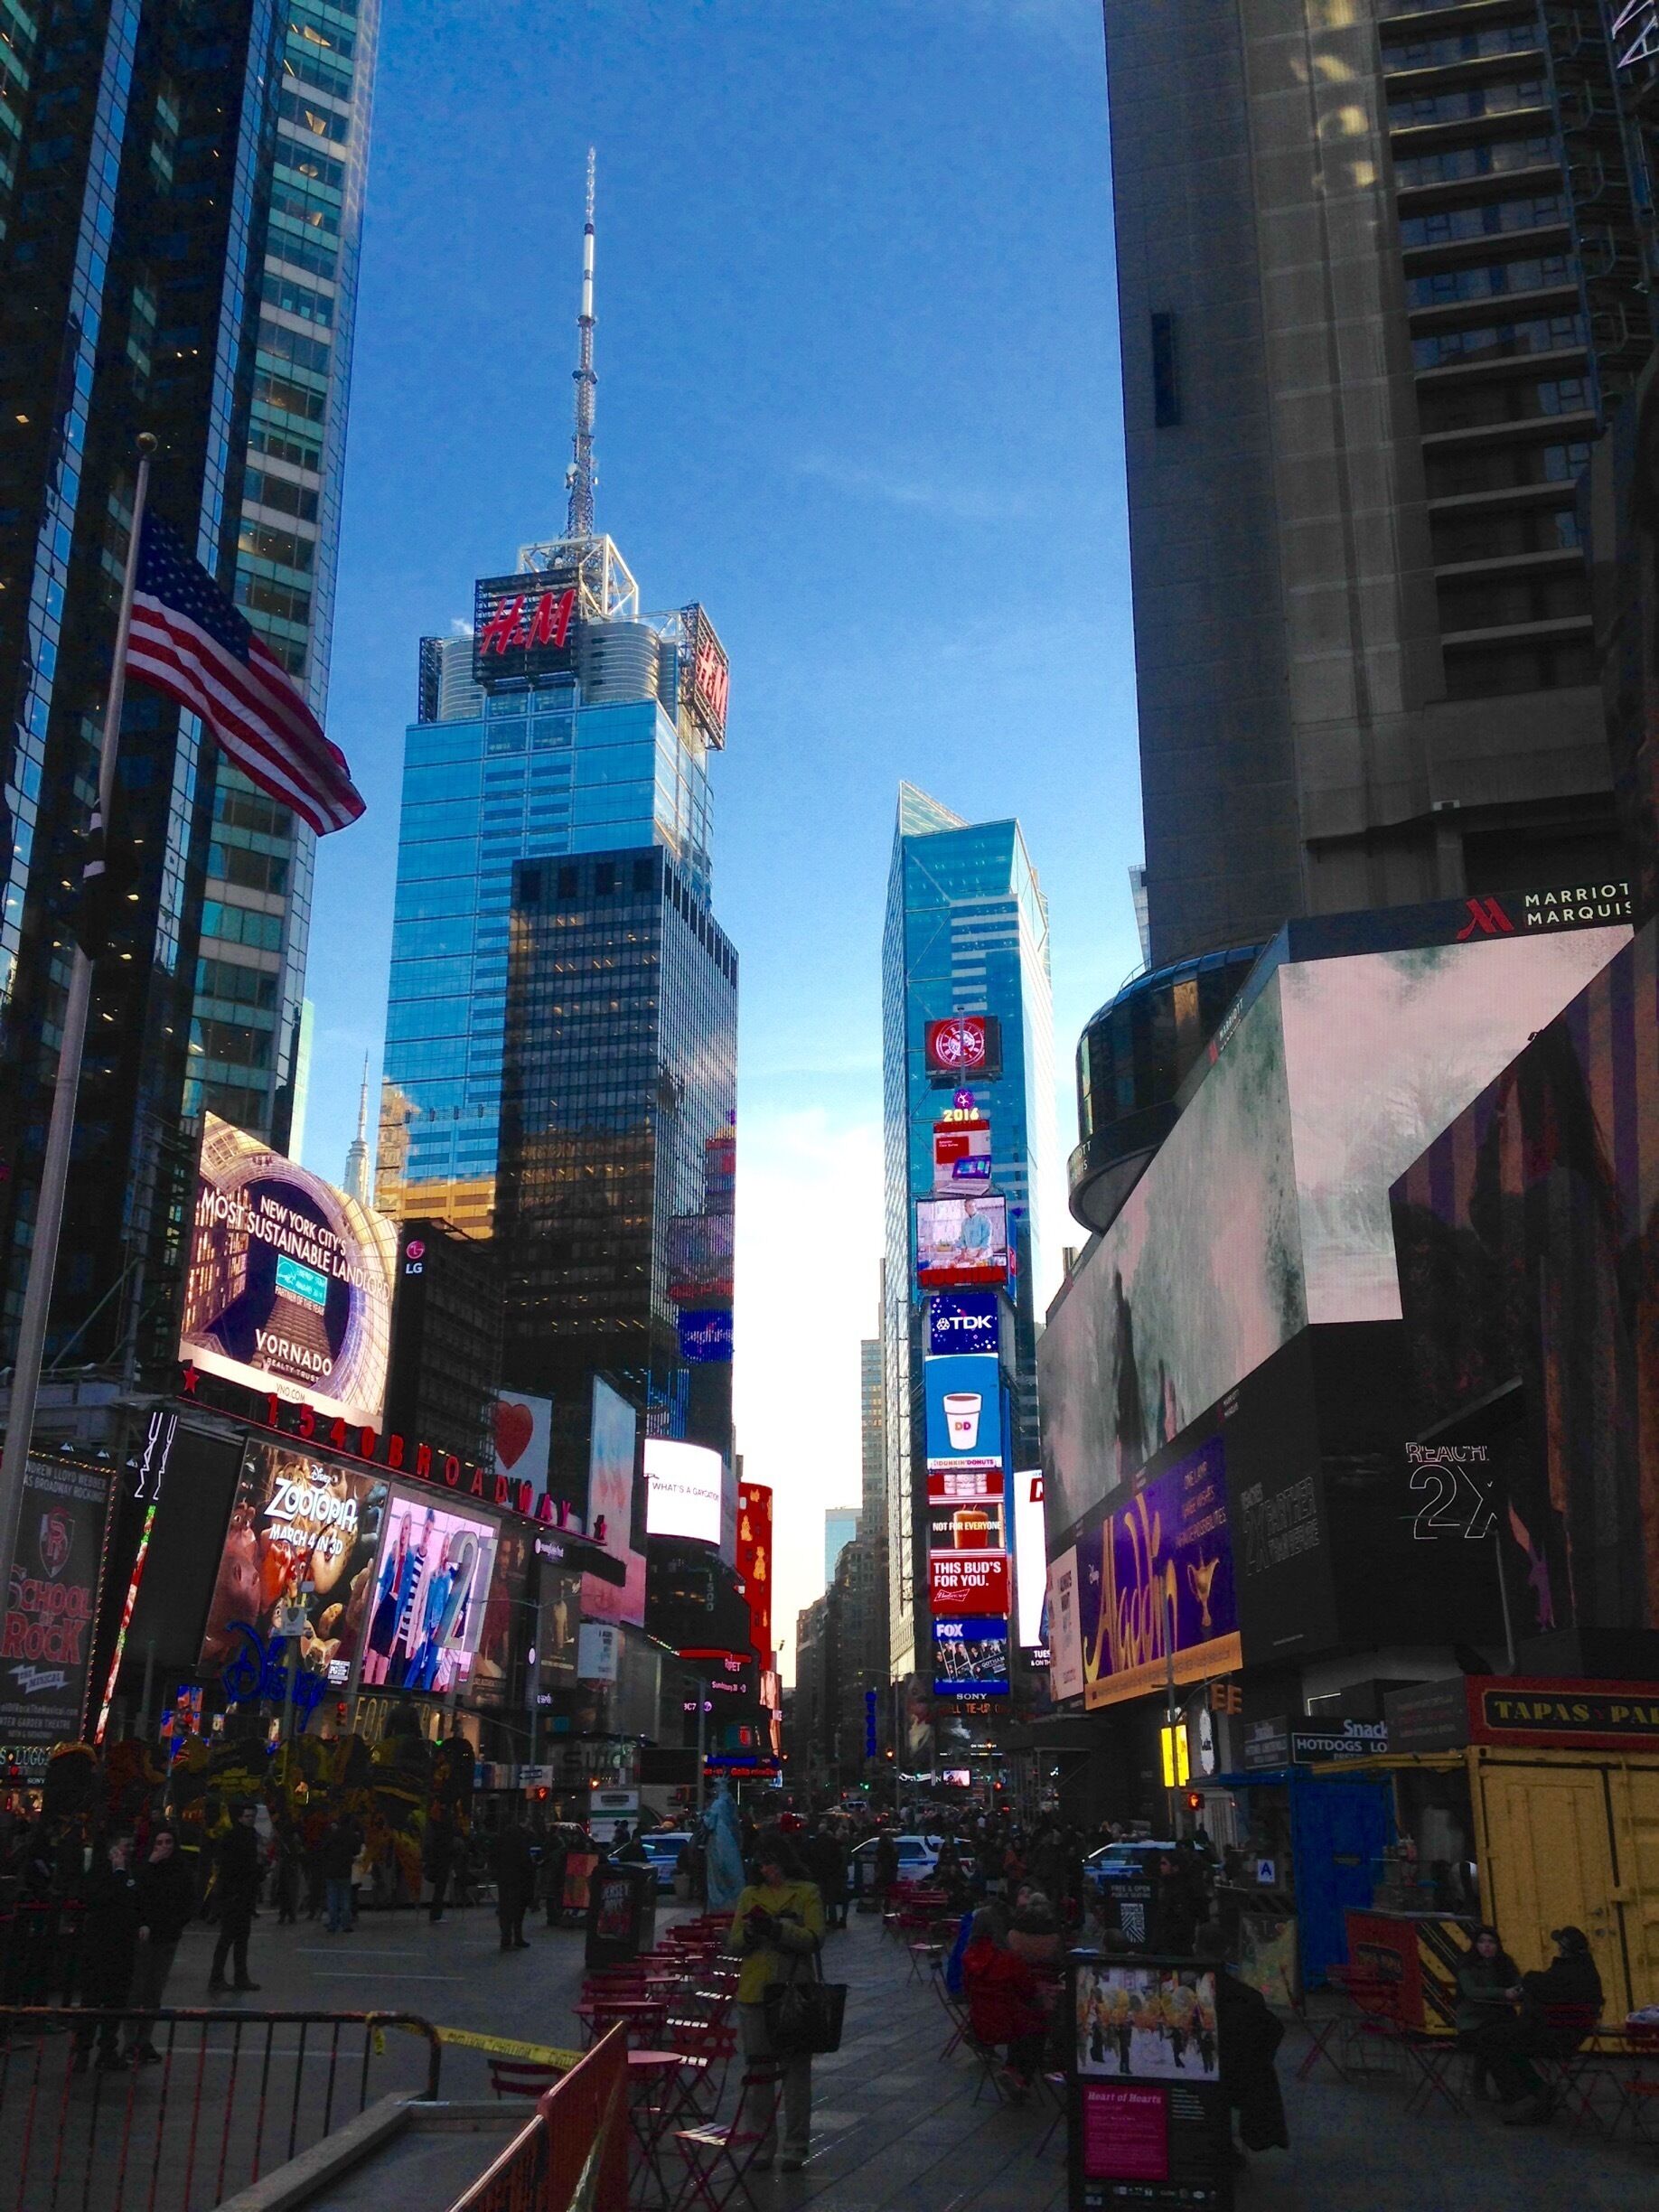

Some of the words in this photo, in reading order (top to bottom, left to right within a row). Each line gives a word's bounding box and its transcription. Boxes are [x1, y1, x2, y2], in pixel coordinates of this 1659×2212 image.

[480, 588, 576, 656] H&M
[943, 1108, 979, 1121] 2016
[260, 1195, 288, 1219] NEW
[289, 1209, 317, 1240] YORK
[318, 1227, 347, 1257] CITY'S
[201, 1186, 244, 1226] MOST
[247, 1212, 331, 1272] SUSTAINABLE
[333, 1256, 390, 1302] LANDLORD
[405, 1262, 423, 1274] LG
[949, 1316, 992, 1329] TDK
[255, 1328, 333, 1376] VORNADO
[954, 1421, 972, 1431] DD
[267, 1393, 376, 1459] 1540
[388, 1433, 572, 1527] BROADWAY
[652, 1483, 685, 1494] WHAT'S
[264, 1477, 358, 1532] ZOOTOPIA
[933, 1522, 948, 1531] NOT
[949, 1522, 963, 1531] FOR
[964, 1521, 1001, 1530] EVERYONE
[269, 1524, 306, 1548] MARCH
[306, 1534, 315, 1550] 4
[316, 1534, 329, 1551] IN
[933, 1561, 961, 1574] THIS
[964, 1561, 1001, 1573] BUD'S
[934, 1575, 958, 1587] FOR
[961, 1574, 989, 1587] YOU.
[936, 1624, 963, 1636] FOX
[0, 1610, 87, 1665] ROCK
[982, 1656, 1006, 1668] GOTHAM
[330, 1666, 338, 1675] PG
[1495, 1701, 1589, 1722] TAPAS
[1297, 1739, 1363, 1753] HOTDOGS
[1261, 1862, 1272, 1876] A
[1088, 2092, 1116, 2102] Heart
[1117, 2093, 1128, 2102] of
[1128, 2093, 1163, 2104] Hearts
